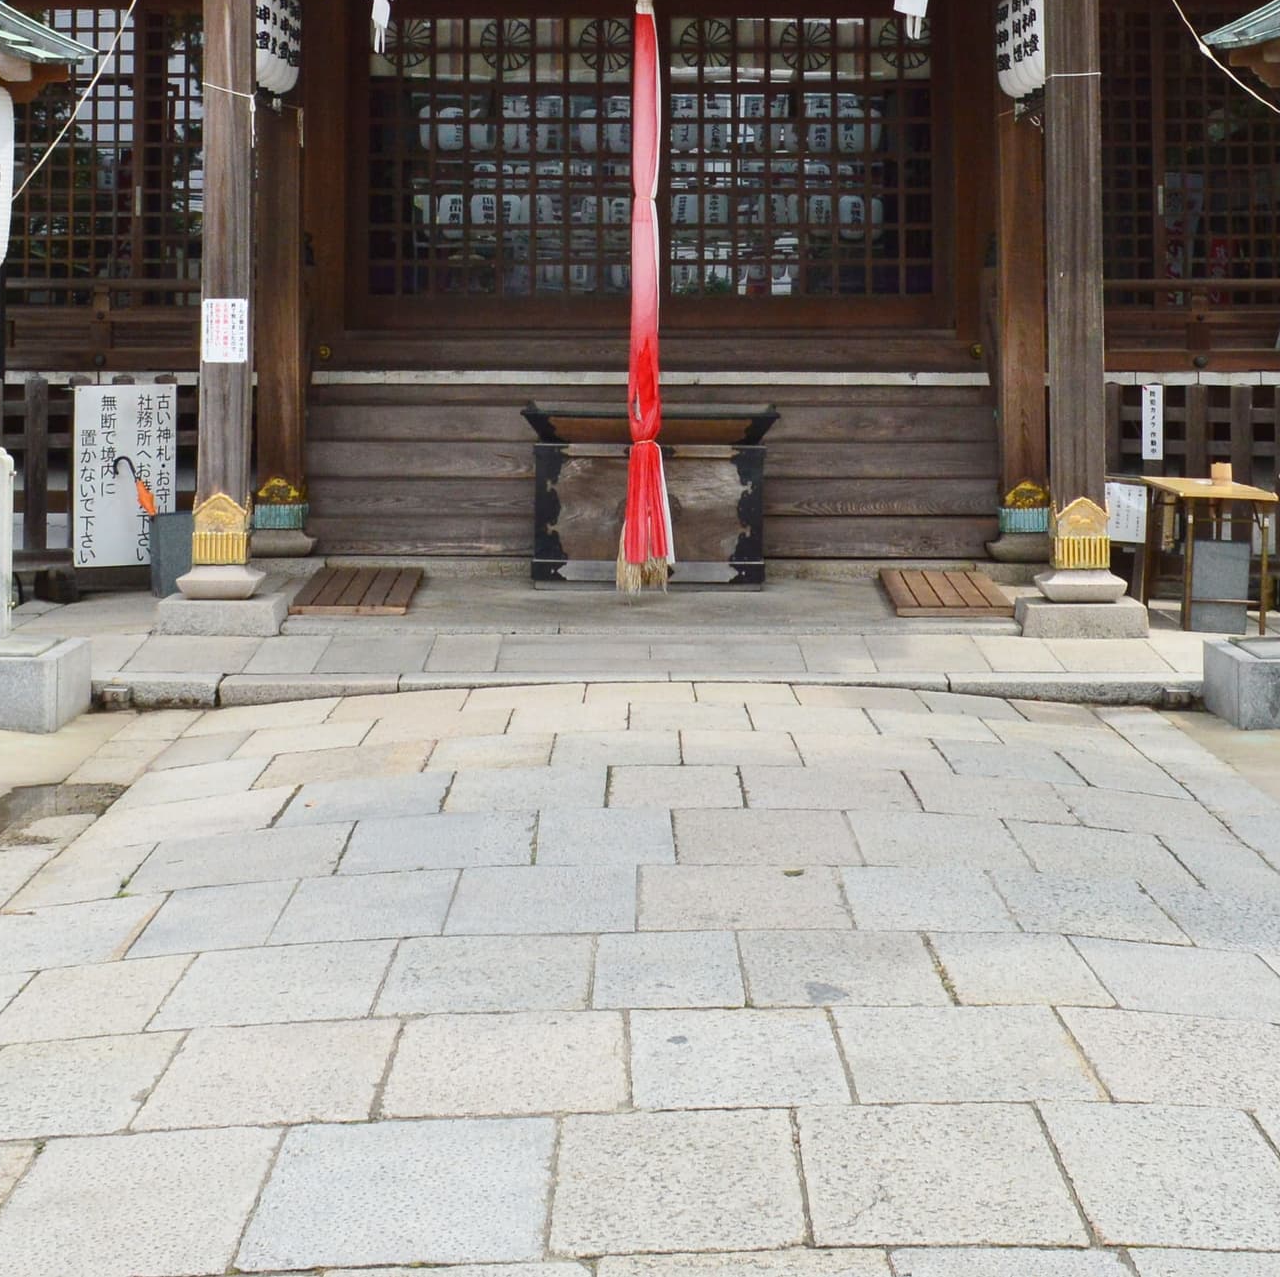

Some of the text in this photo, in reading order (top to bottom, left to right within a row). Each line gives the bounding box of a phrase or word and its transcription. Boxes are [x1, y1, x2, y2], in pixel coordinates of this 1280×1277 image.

[80, 429, 97, 564] 置かないで下さい
[100, 395, 117, 497] 無断で境内に
